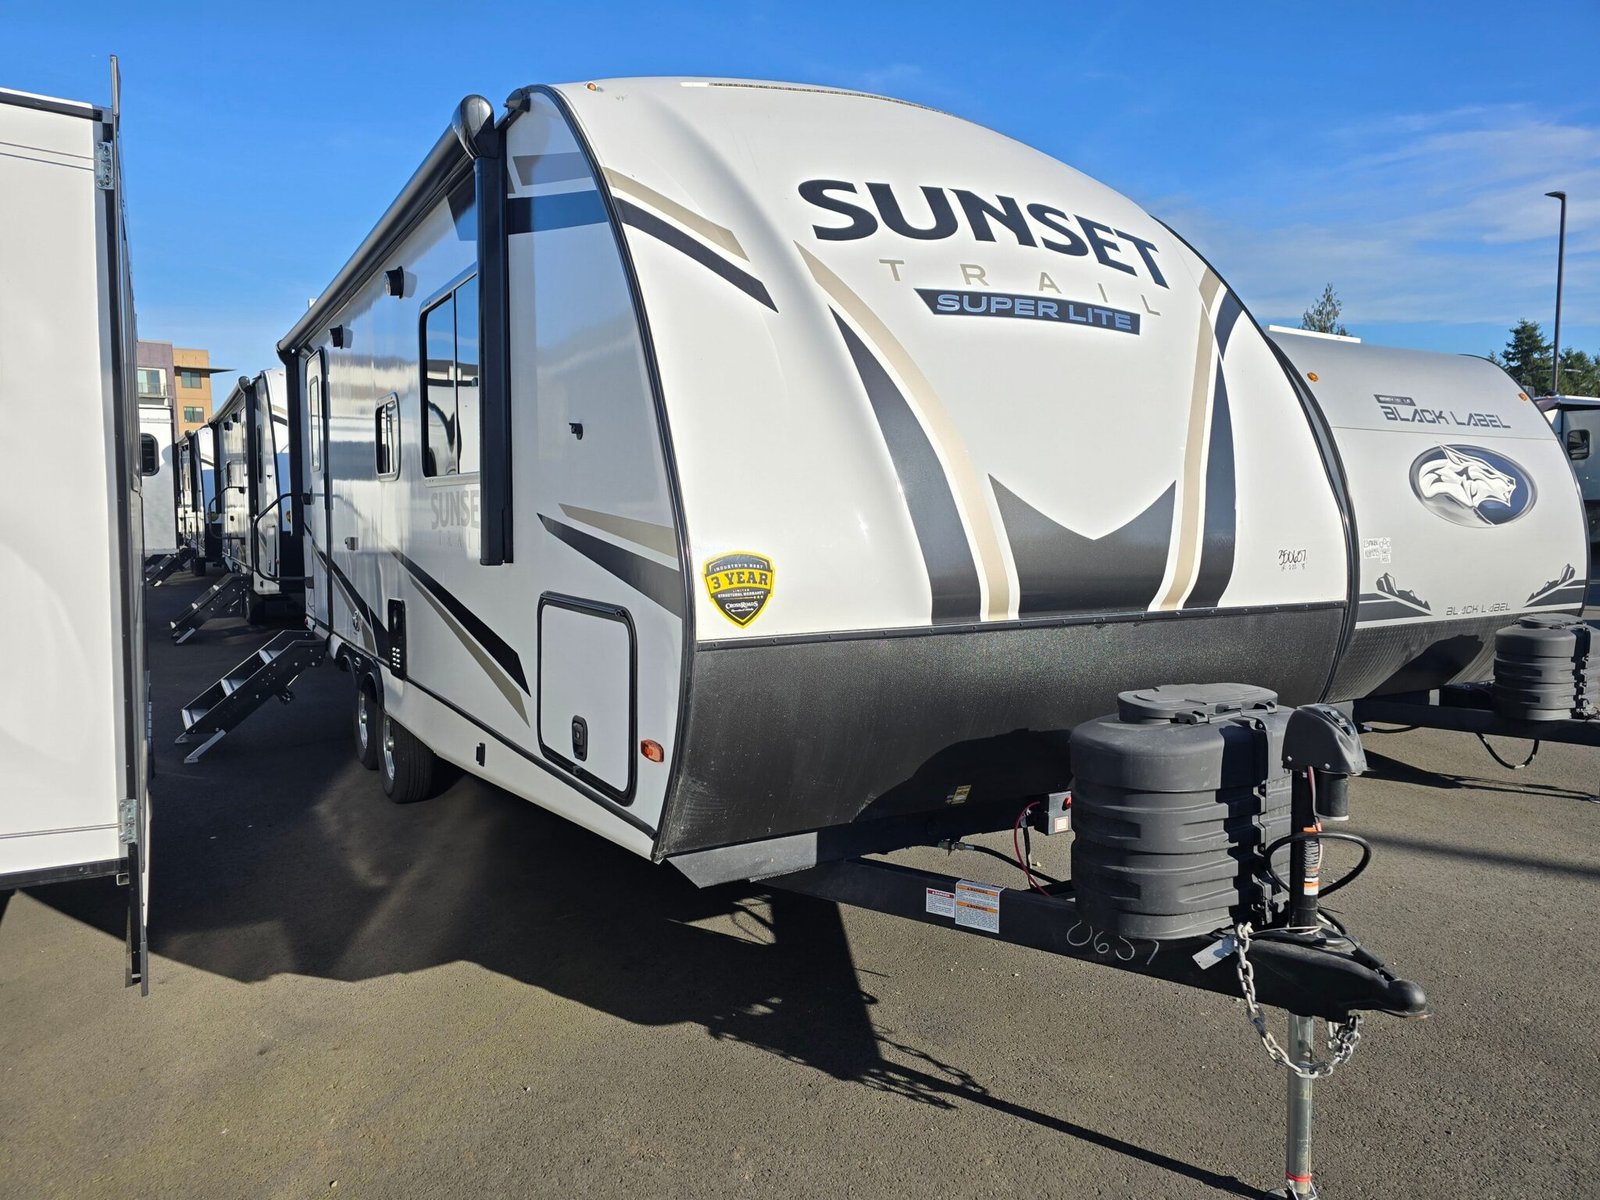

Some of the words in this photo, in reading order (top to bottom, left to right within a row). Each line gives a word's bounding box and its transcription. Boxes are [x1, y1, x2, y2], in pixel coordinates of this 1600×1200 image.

[798, 179, 1170, 290] SUNSET
[879, 258, 1161, 316] TRAIL
[936, 294, 1058, 319] SUPER
[1068, 304, 1133, 330] LITE
[1379, 405, 1450, 425] BLACK
[1450, 411, 1512, 429] LABEL
[431, 490, 480, 530] SUNSE
[710, 576, 721, 590] 3
[724, 571, 769, 586] YEAR
[1446, 605, 1479, 616] BLACK
[1481, 602, 1511, 613] LABEL
